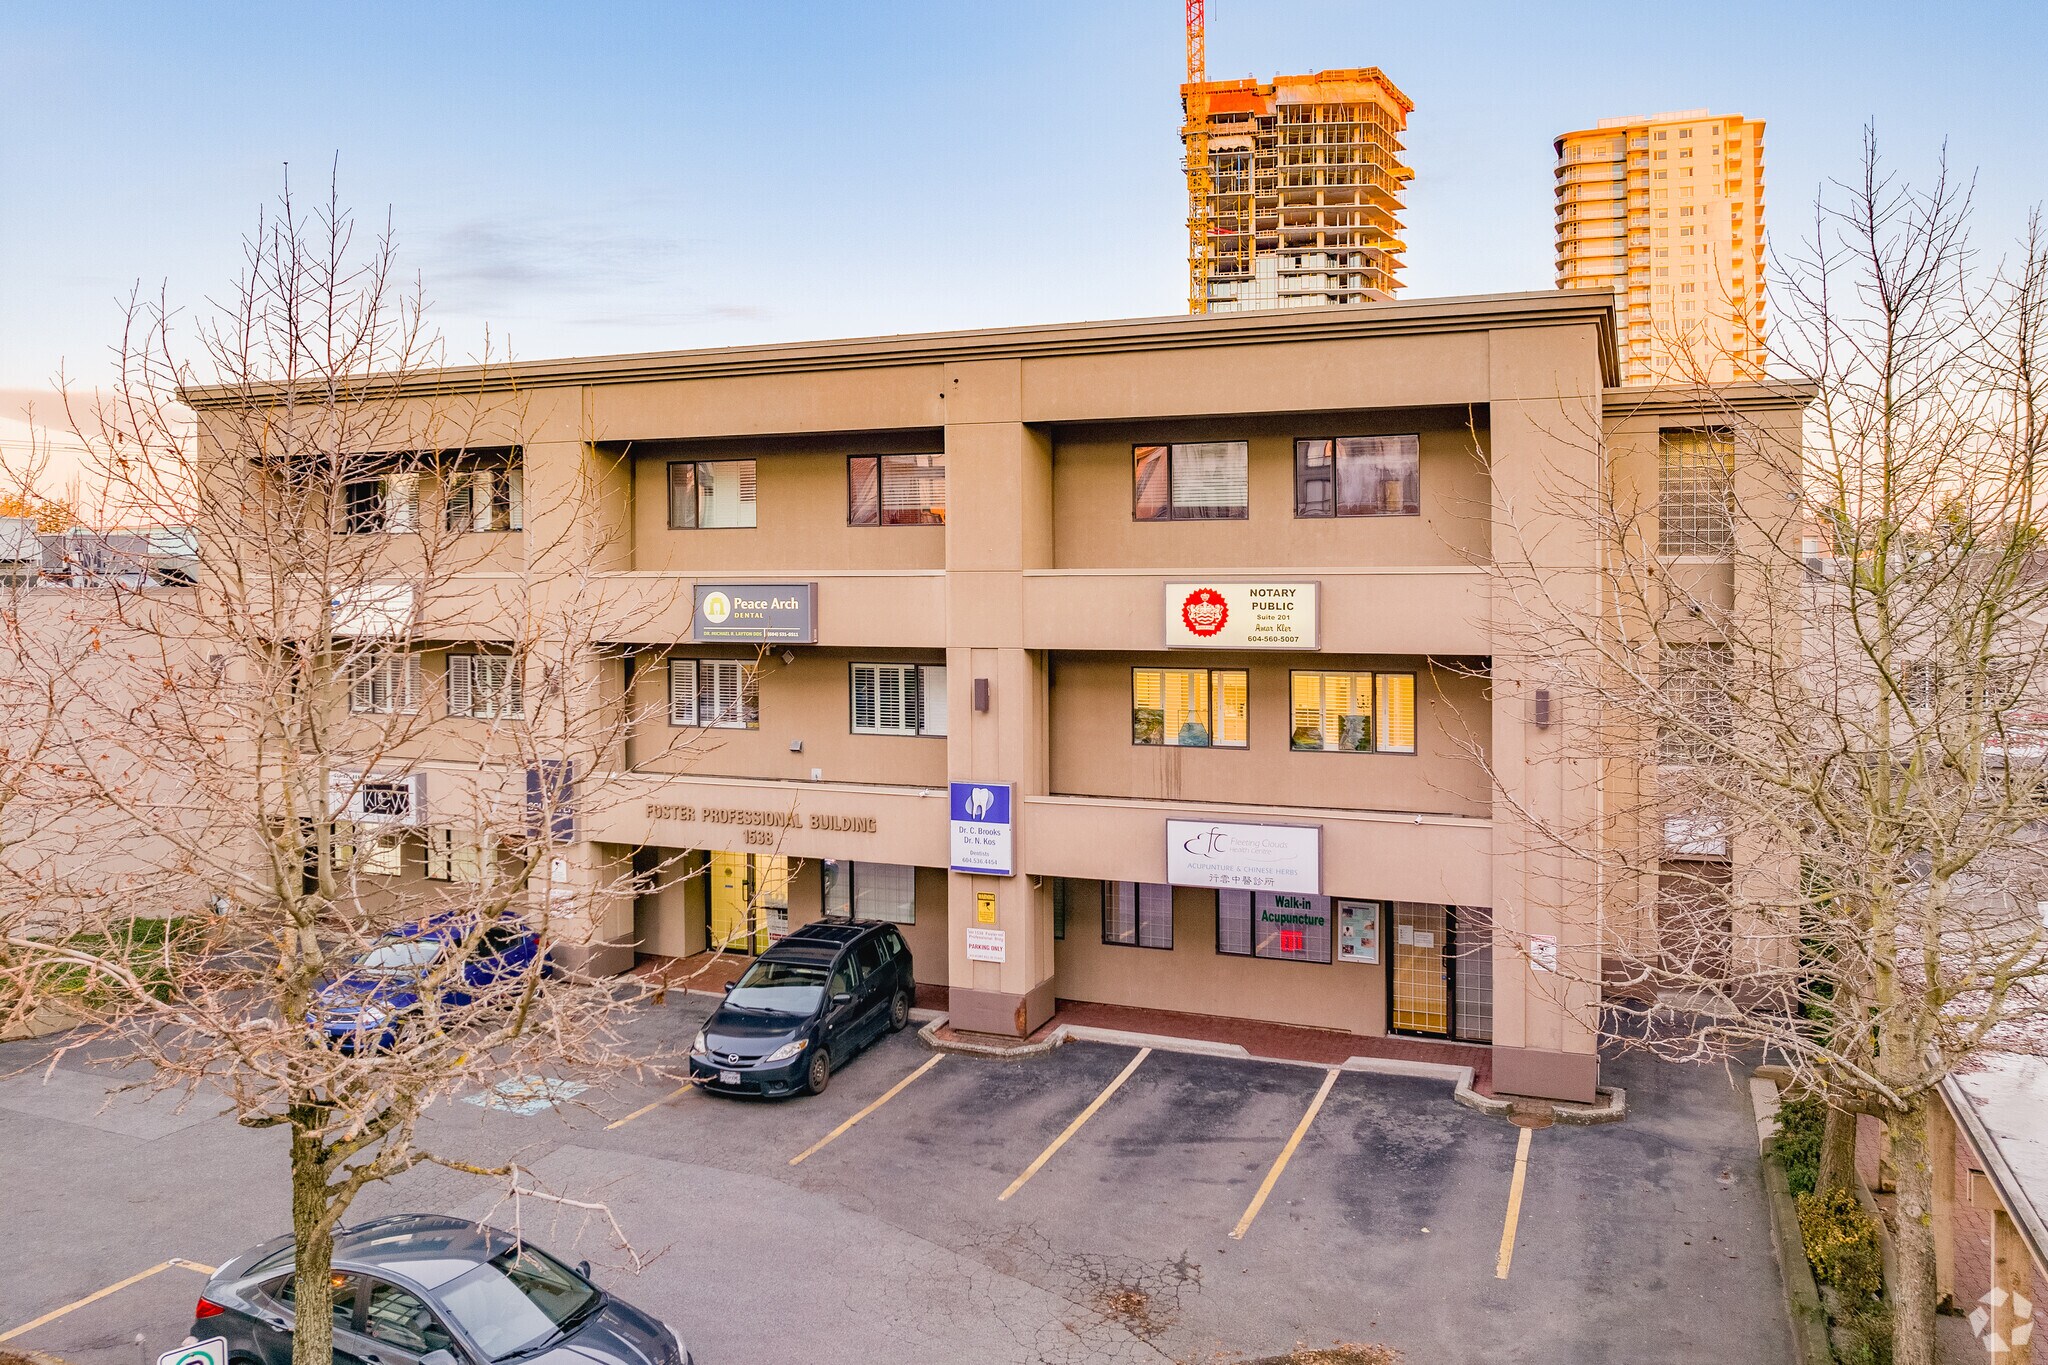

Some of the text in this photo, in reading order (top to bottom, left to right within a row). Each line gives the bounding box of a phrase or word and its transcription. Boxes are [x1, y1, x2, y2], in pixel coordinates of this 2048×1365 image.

[1249, 588, 1297, 598] NOTARY
[733, 596, 799, 610] Peace Arch
[1251, 602, 1294, 611] PUBLIC
[1247, 635, 1300, 643] 604-560-5007
[645, 803, 878, 834] FOSTER PROFESSIONAL BUILDING
[958, 826, 968, 834] Dr.
[977, 827, 1001, 837] Brooks
[742, 829, 774, 846] 1538
[963, 836, 974, 844] Dr.
[983, 837, 996, 846] Kos
[1230, 837, 1288, 848] Fleeting Clouds
[1243, 866, 1273, 874] CHINESE
[1275, 868, 1298, 876] HERBS
[1275, 895, 1312, 910] Walk-in
[1261, 909, 1325, 927] Acupuncture
[968, 943, 990, 951] PARKING
